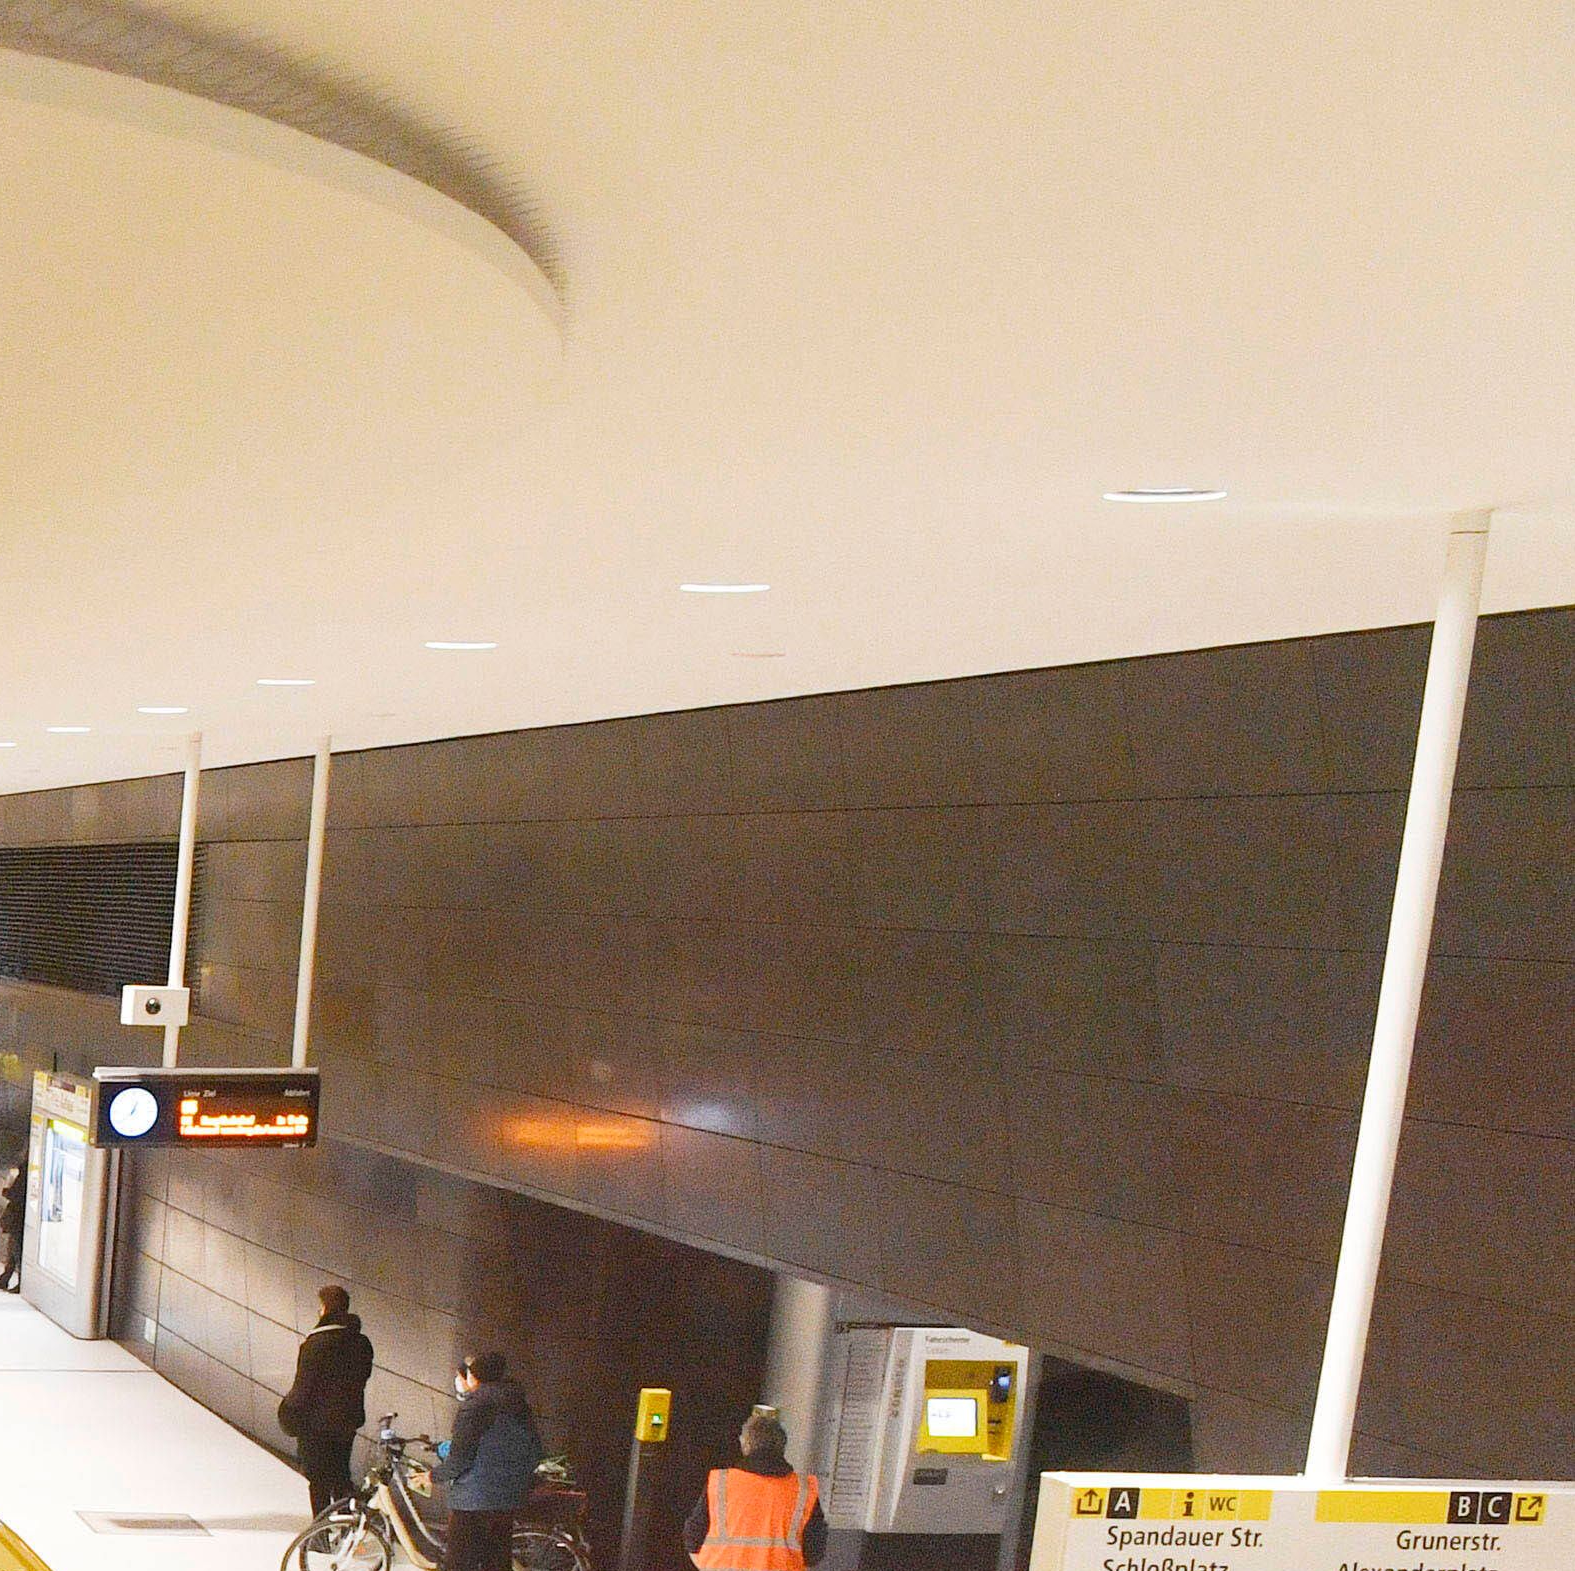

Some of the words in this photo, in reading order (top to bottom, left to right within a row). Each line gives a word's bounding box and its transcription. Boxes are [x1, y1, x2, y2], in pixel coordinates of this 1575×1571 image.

[1114, 1490, 1131, 1512] A
[1209, 1496, 1237, 1512] WC
[1457, 1496, 1471, 1517] B
[1487, 1496, 1503, 1518] C
[1106, 1525, 1224, 1551] Spandauer
[1230, 1527, 1264, 1547] Str.
[1396, 1530, 1502, 1551] Grunerstr.
